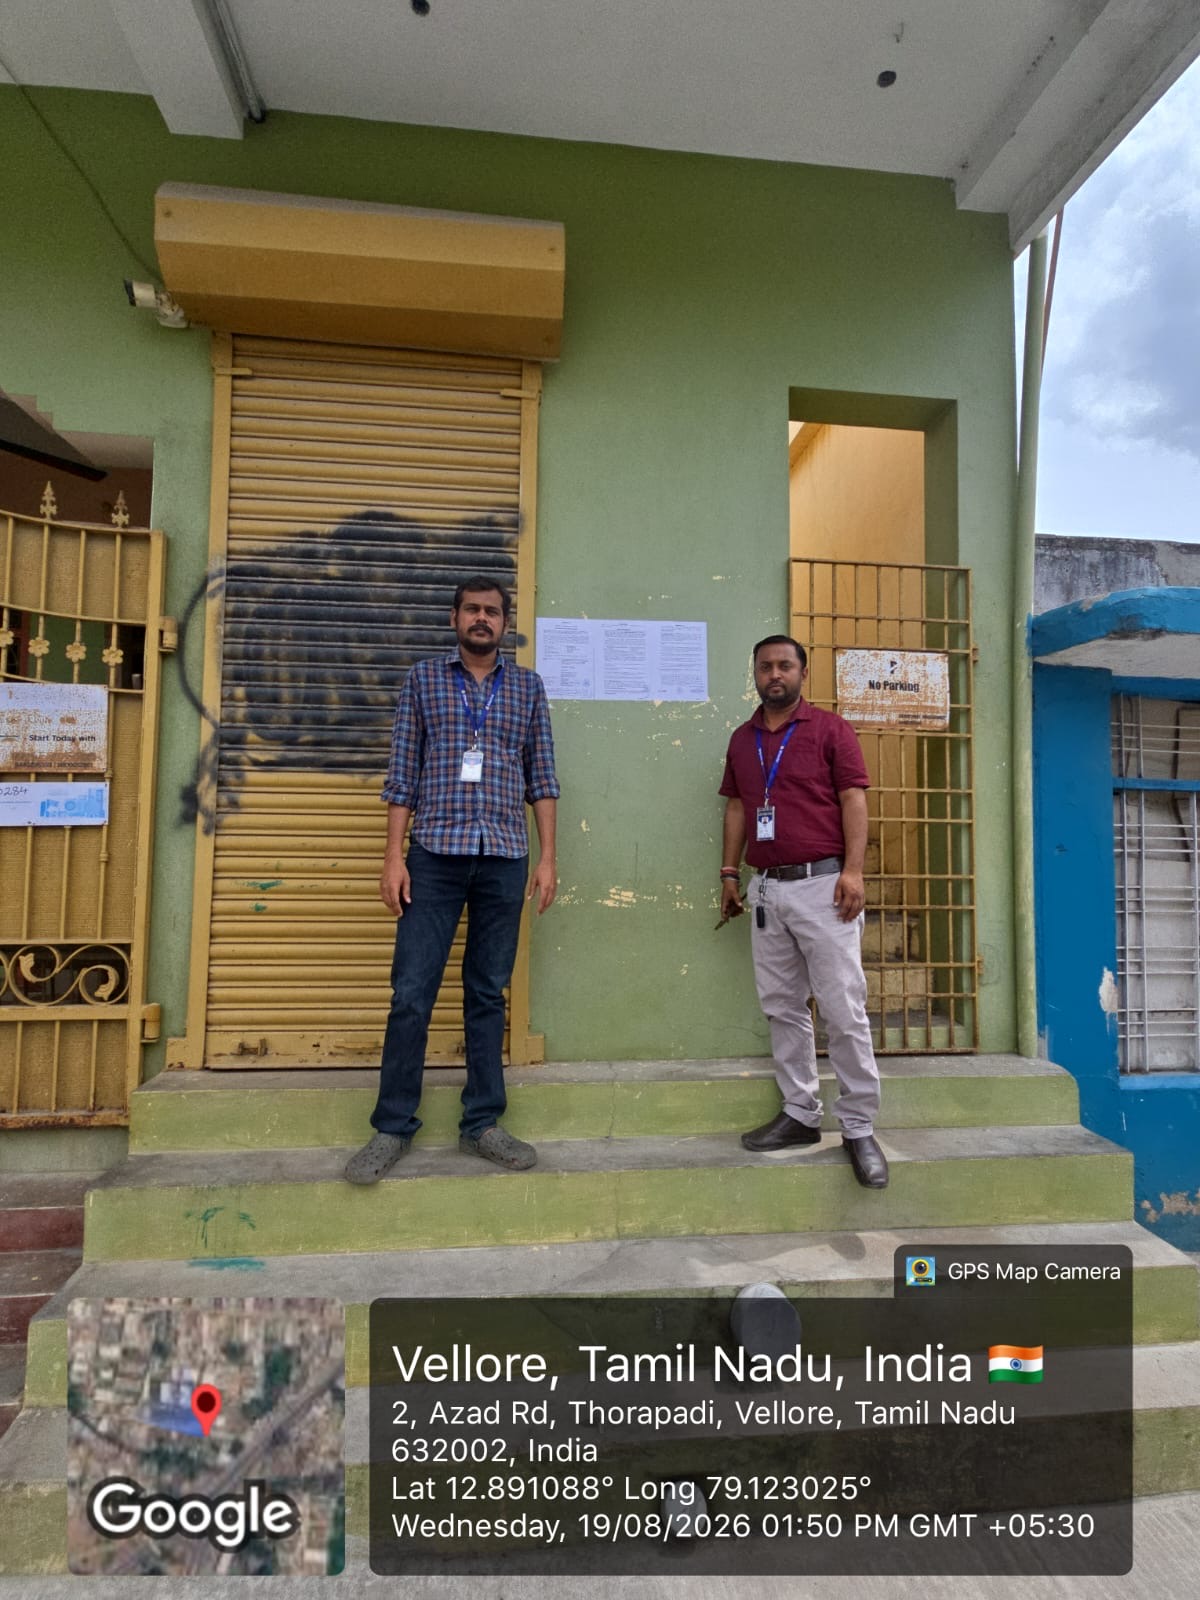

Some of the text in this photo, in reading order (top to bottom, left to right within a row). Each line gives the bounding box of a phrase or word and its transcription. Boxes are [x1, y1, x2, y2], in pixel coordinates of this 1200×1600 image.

[868, 679, 920, 693] No Parking
[29, 734, 96, 743] Start Today with
